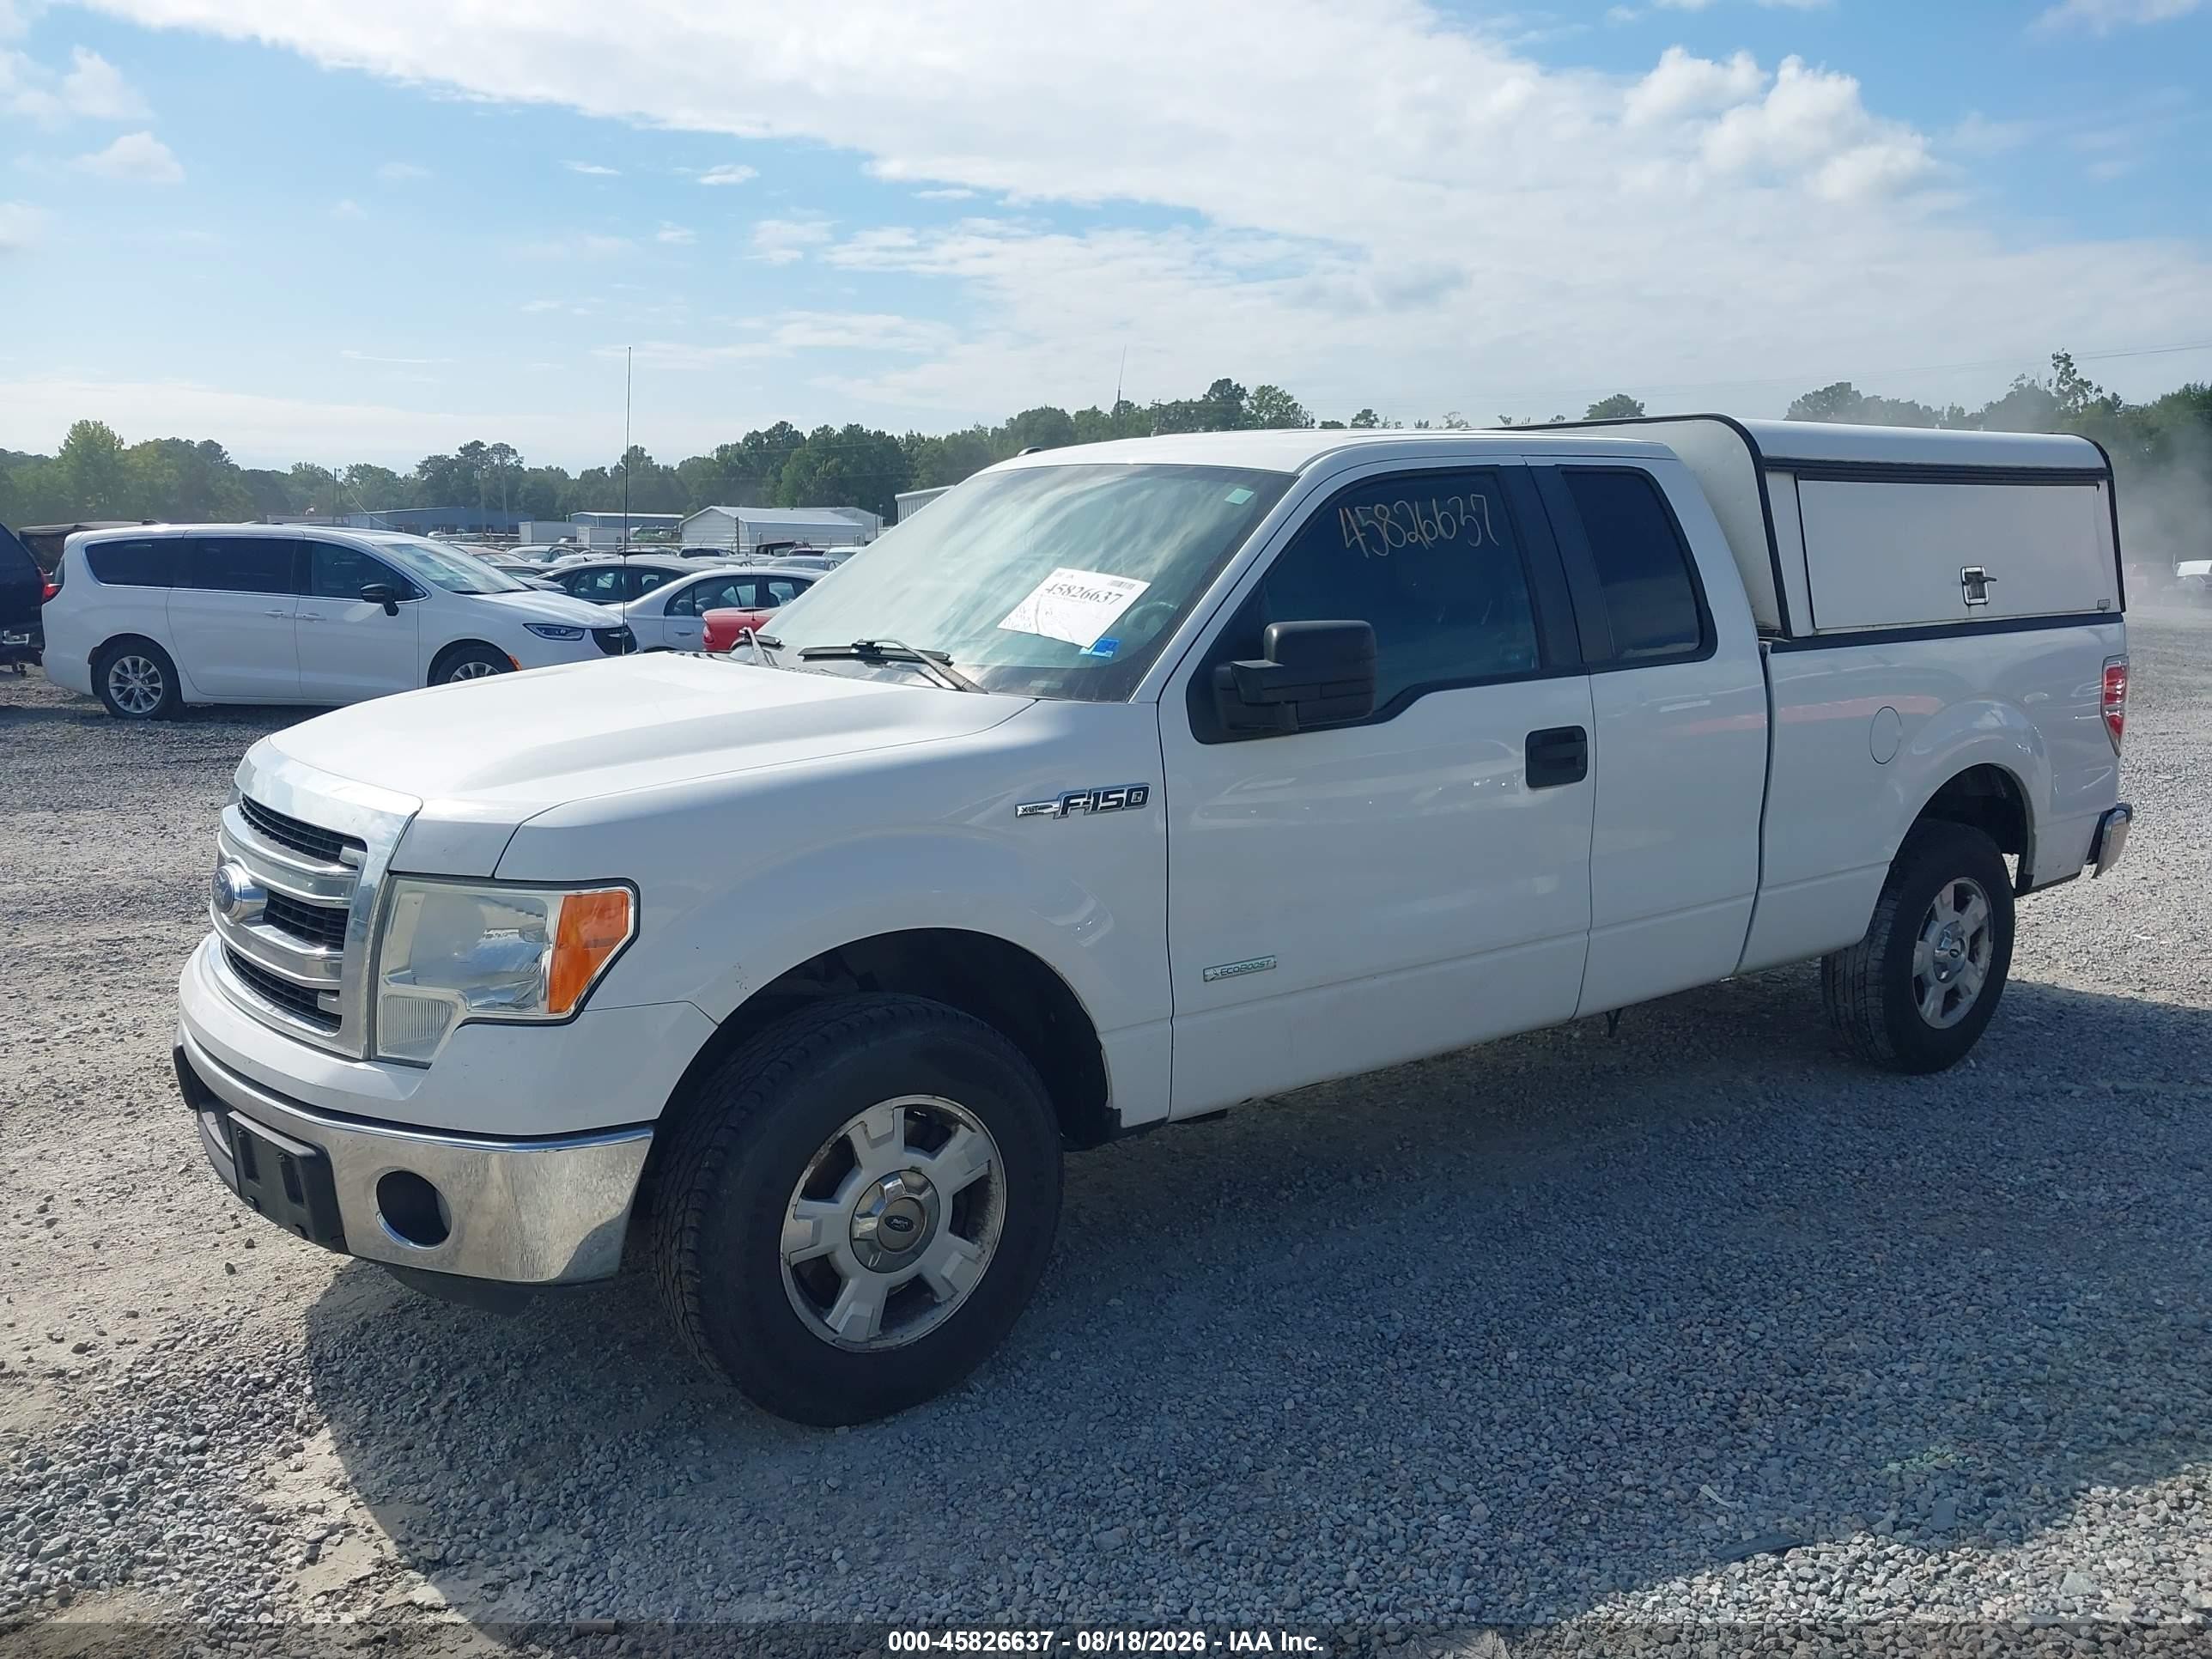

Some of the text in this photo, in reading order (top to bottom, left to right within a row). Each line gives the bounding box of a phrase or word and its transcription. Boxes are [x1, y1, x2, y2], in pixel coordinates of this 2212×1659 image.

[1339, 494, 1500, 558] 45826637
[1044, 582, 1124, 605] 45826637
[1060, 786, 1150, 816] F-150
